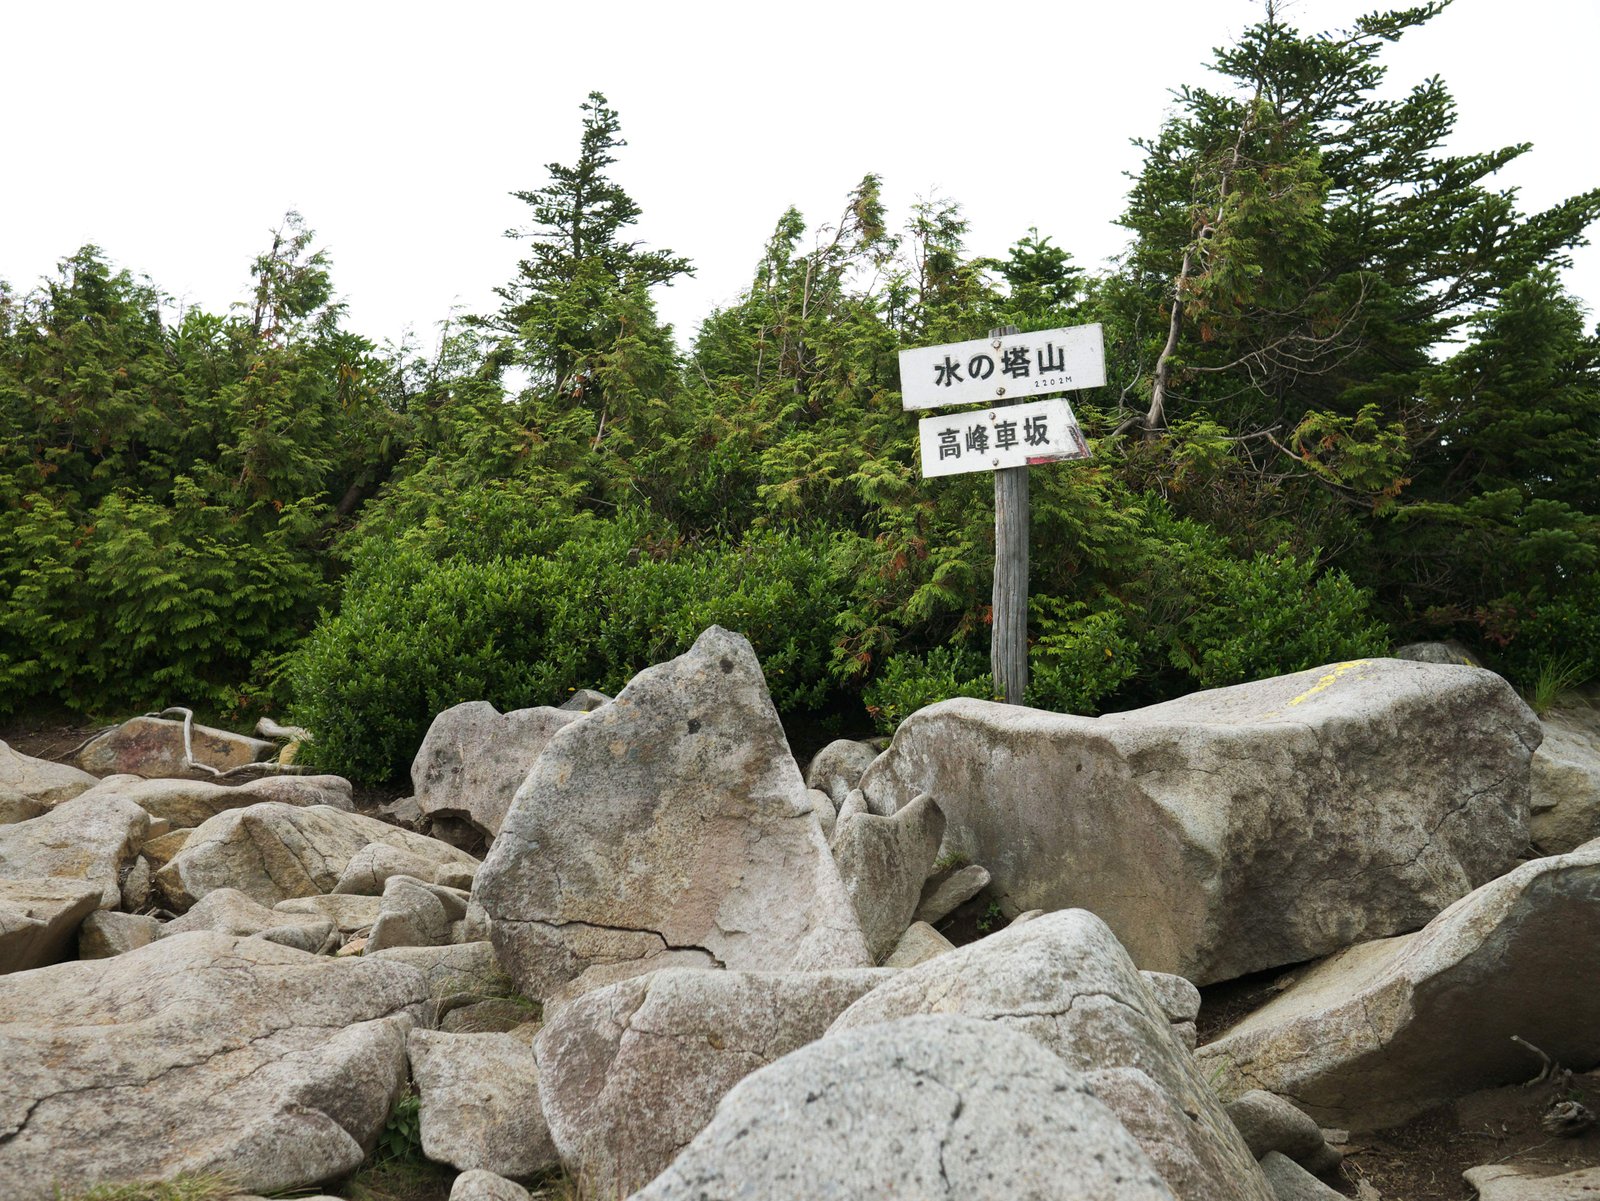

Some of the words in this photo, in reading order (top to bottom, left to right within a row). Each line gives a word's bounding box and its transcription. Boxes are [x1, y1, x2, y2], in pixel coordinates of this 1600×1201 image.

[934, 343, 1066, 388] 水の塔山
[1034, 376, 1073, 388] 2202M
[937, 415, 1051, 460] 高峰車坂
